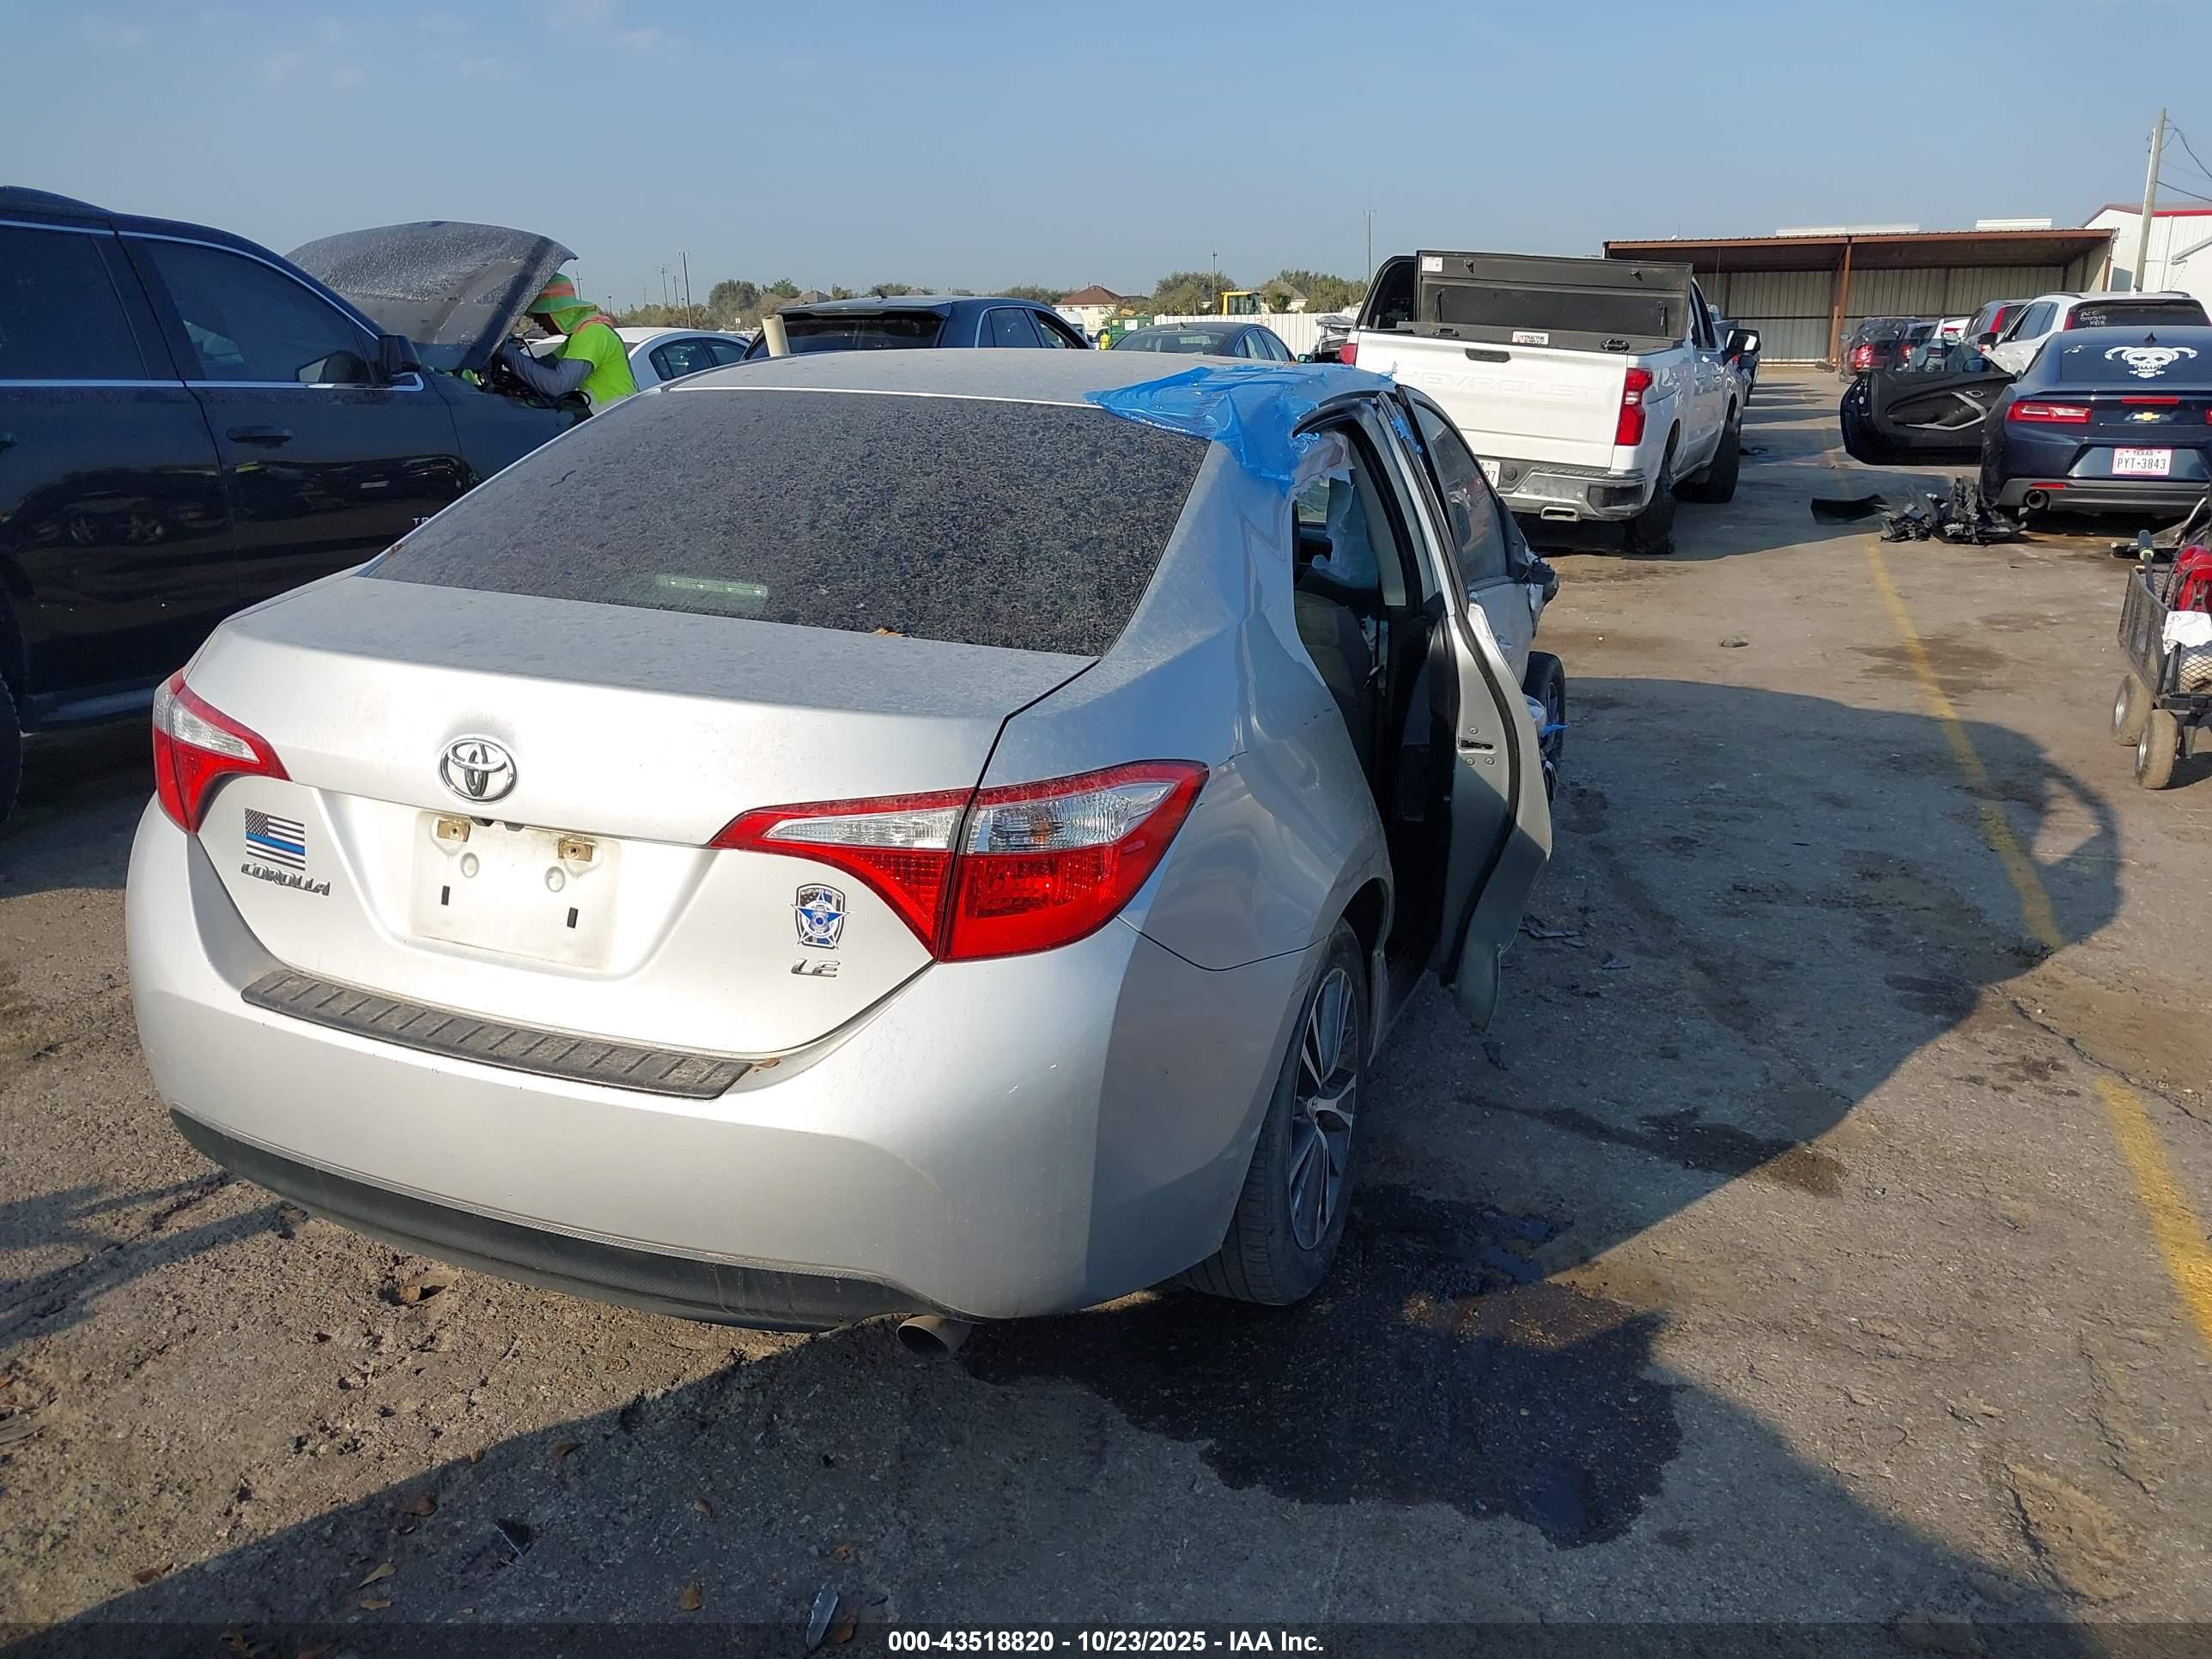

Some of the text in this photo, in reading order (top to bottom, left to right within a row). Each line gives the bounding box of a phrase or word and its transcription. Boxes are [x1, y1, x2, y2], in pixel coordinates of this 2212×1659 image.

[1395, 371, 1602, 400] HEVROLET
[2117, 458, 2166, 470] PYT-3843
[241, 862, 331, 896] COROLLA
[791, 958, 841, 978] LE
